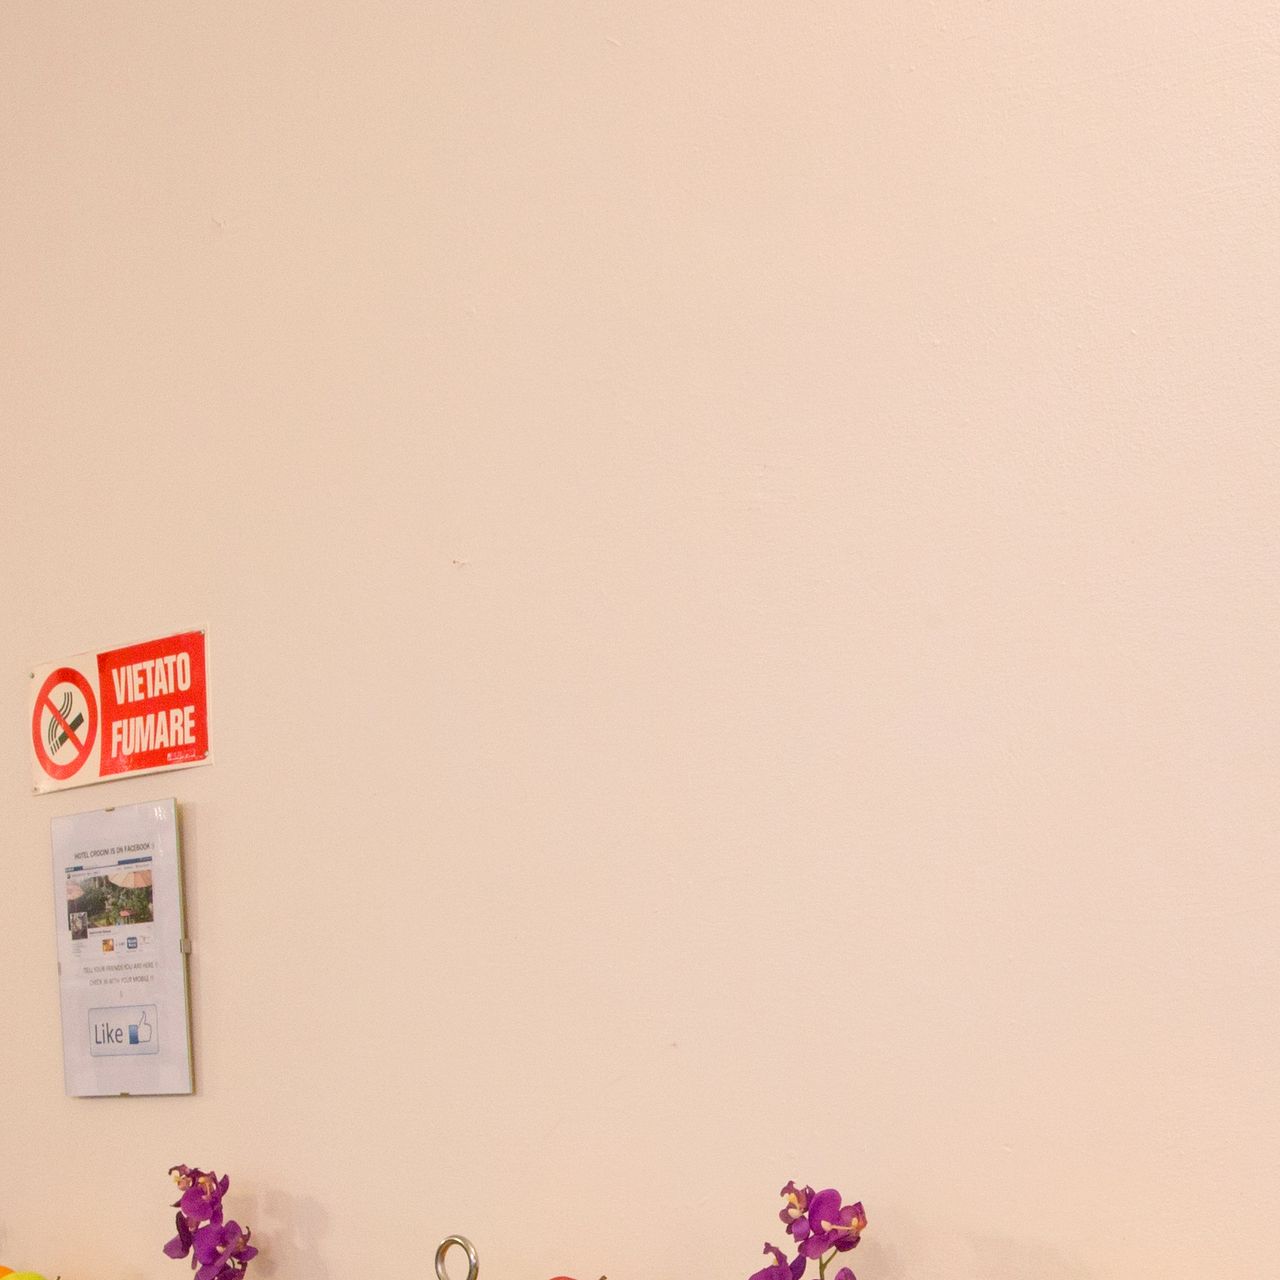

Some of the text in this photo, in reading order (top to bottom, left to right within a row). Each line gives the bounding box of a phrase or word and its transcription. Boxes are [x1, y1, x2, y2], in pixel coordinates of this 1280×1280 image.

[111, 652, 192, 705] VIETATO
[111, 705, 196, 759] FUMARE
[124, 842, 150, 853] FACEBOOK
[94, 1022, 123, 1045] Like
